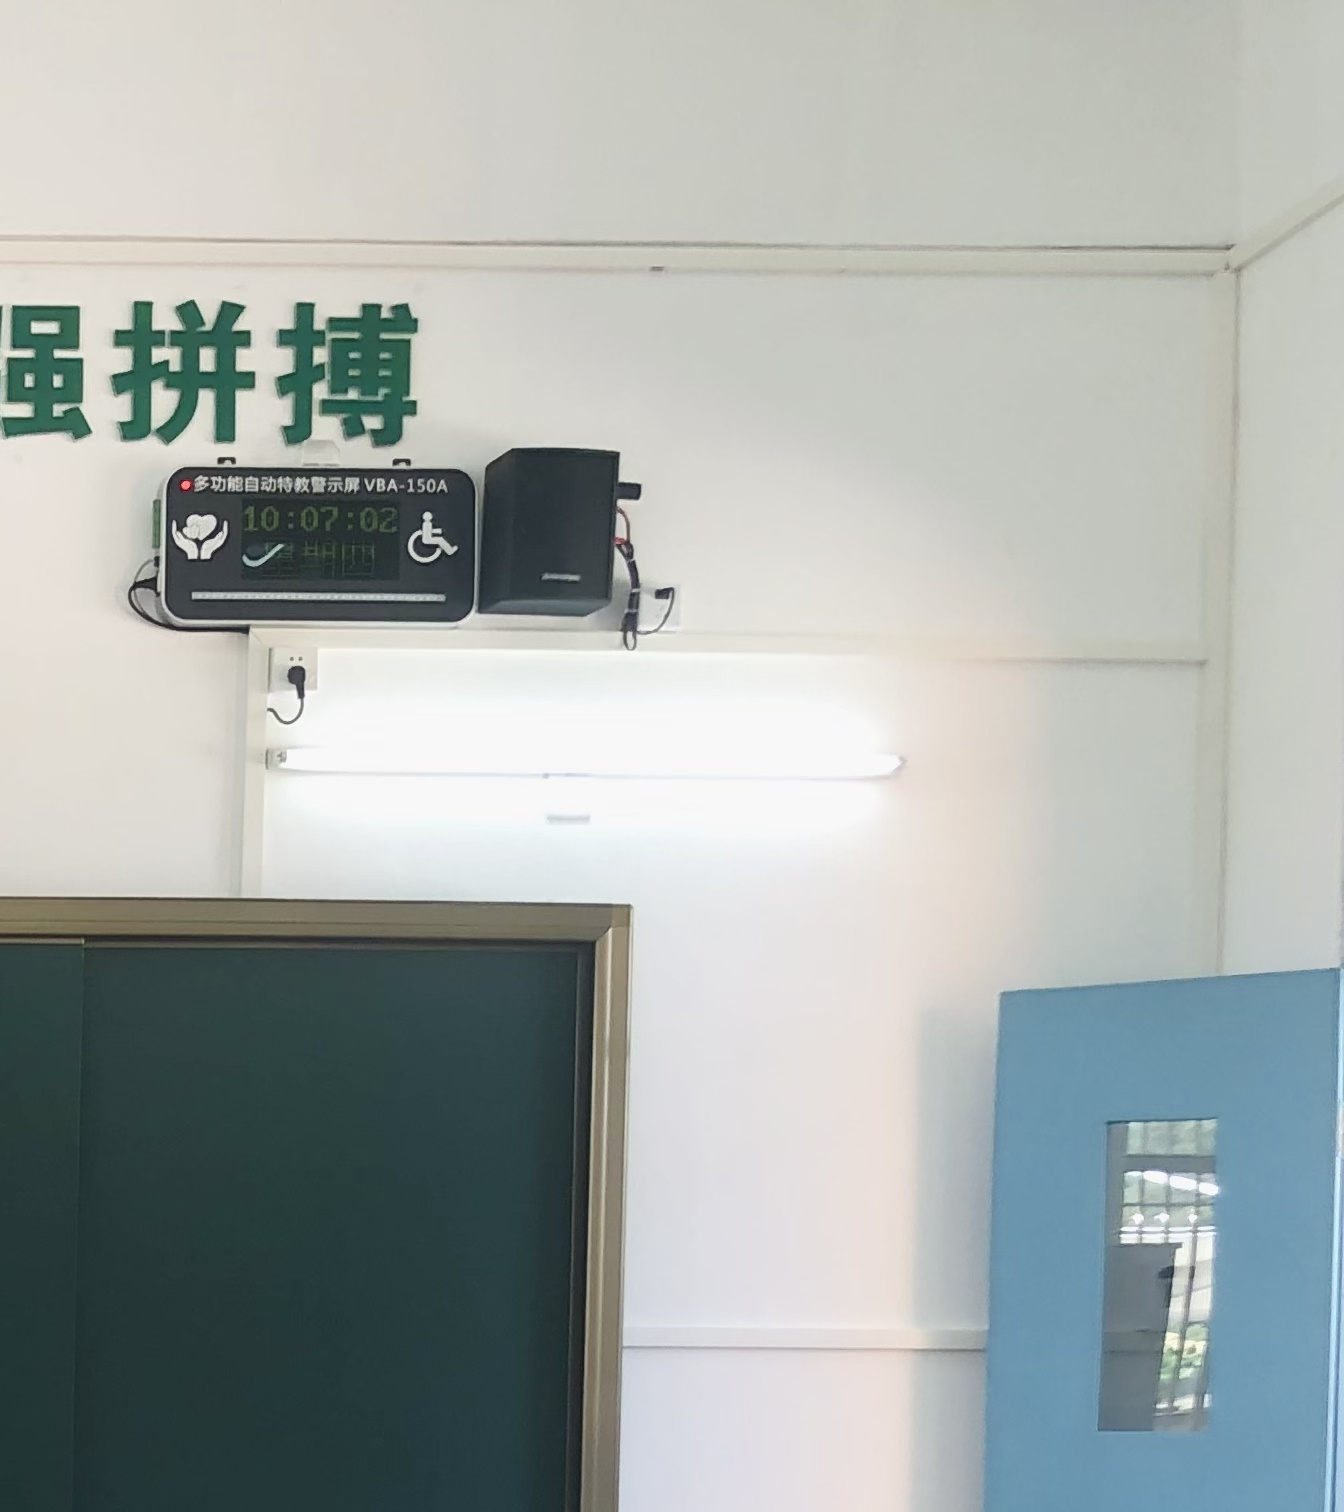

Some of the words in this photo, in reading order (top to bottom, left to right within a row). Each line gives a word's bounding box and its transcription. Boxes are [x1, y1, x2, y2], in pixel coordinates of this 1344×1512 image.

[193, 475, 361, 494] 多功能自动特教警示屏
[364, 477, 448, 494] VBA-150A
[243, 505, 398, 533] 10:07:02
